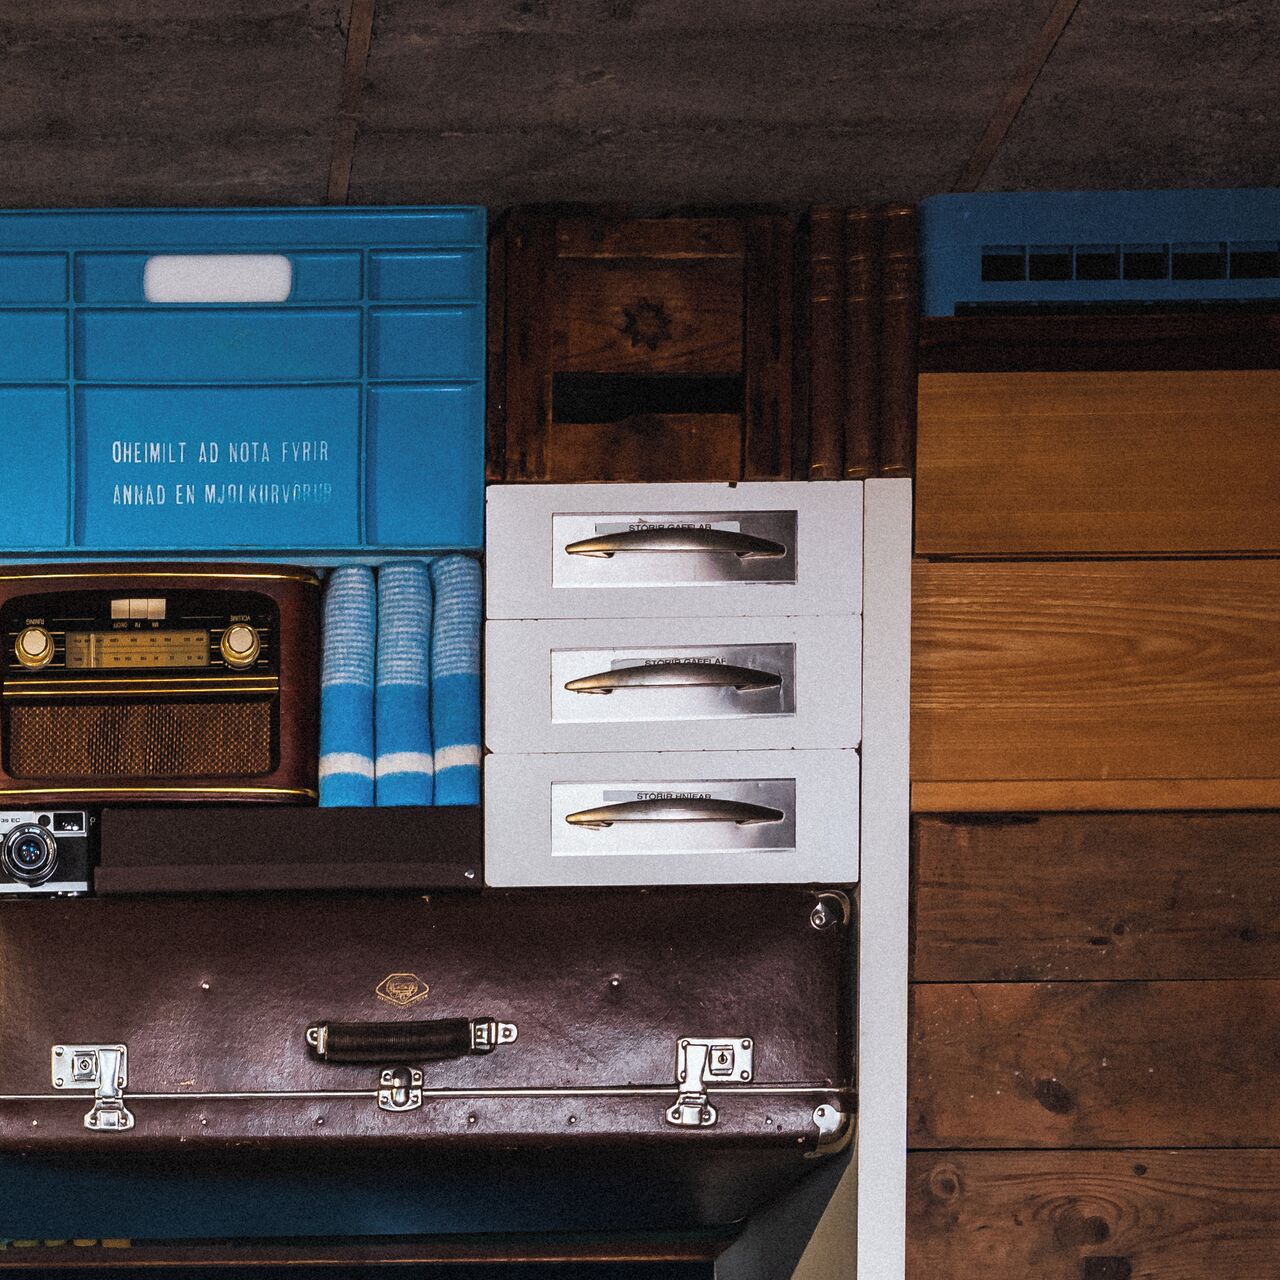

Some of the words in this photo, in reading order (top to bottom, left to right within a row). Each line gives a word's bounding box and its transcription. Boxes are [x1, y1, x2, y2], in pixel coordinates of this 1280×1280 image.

[229, 441, 270, 463] NOTA
[281, 440, 329, 463] FYRIR
[175, 484, 195, 505] EN
